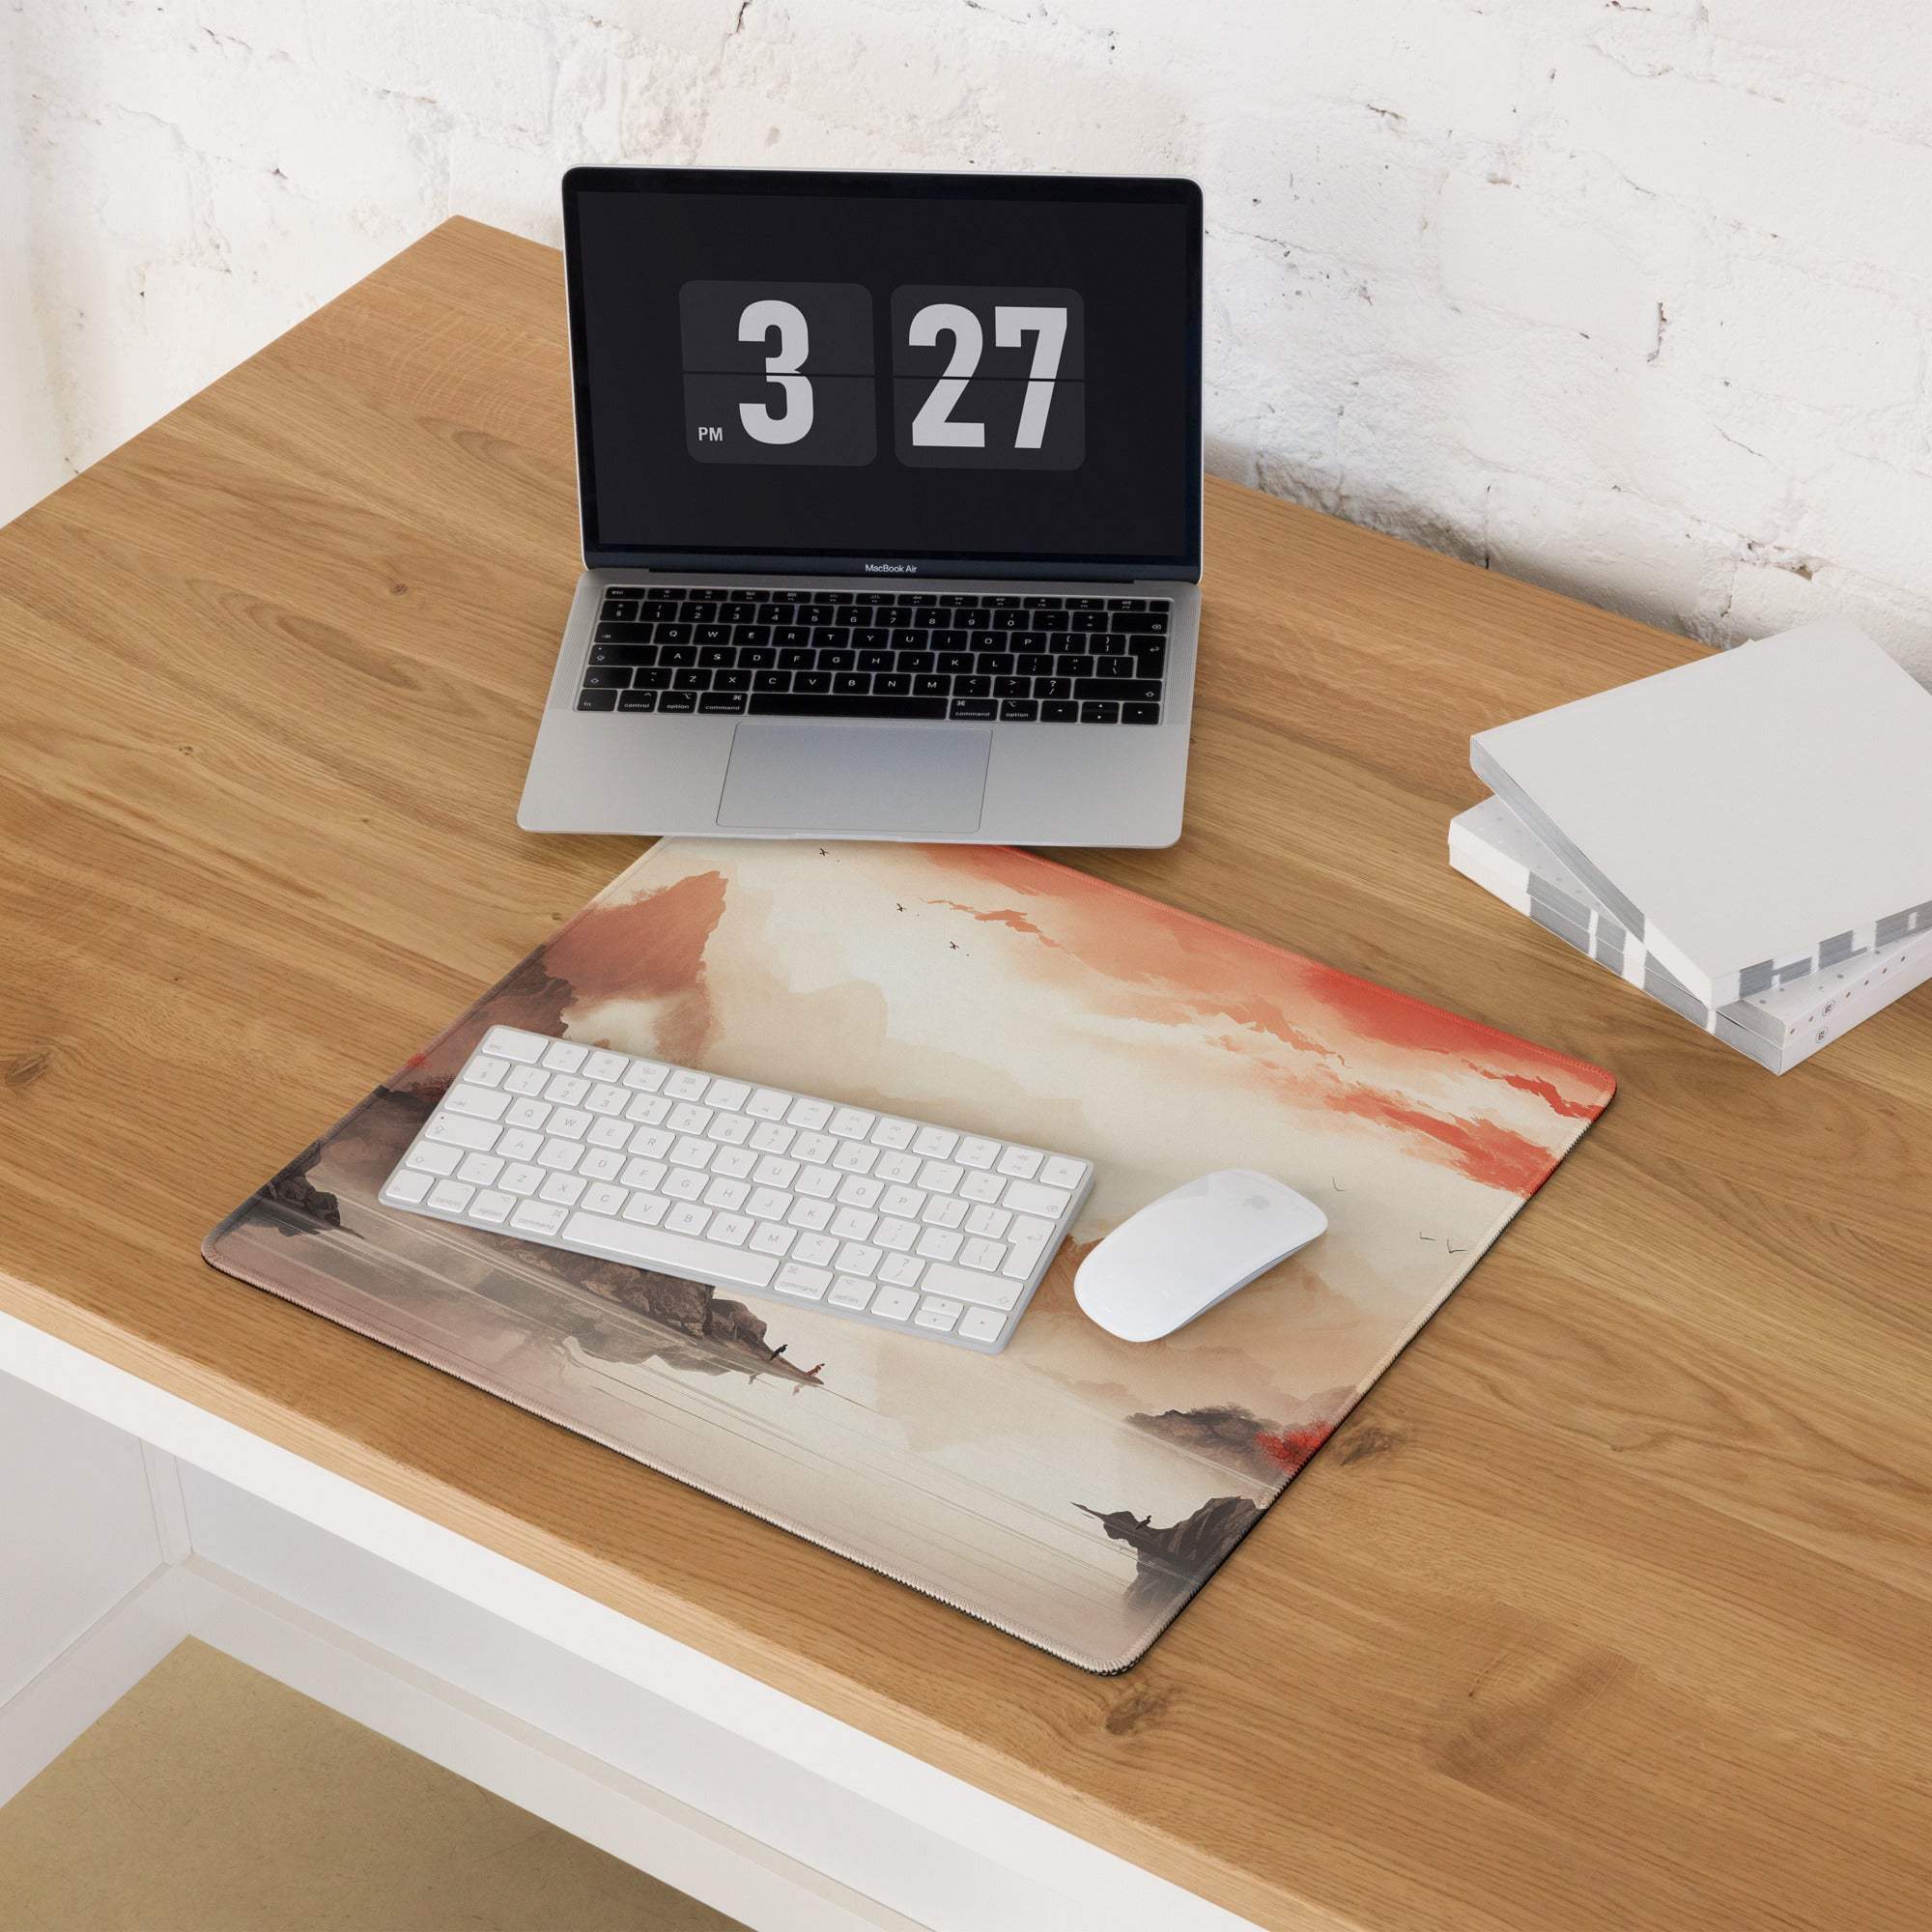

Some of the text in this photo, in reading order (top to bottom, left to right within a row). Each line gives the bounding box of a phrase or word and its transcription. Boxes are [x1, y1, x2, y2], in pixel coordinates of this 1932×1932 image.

[738, 299, 1067, 449] 3 27
[698, 426, 723, 441] PM
[865, 563, 917, 572] MacBook Air
[561, 1090, 570, 1098] 2
[524, 1109, 534, 1117] Q
[565, 1119, 577, 1127] W
[647, 1138, 656, 1146] R
[597, 1159, 607, 1168] D
[772, 1166, 782, 1175] U
[517, 1174, 527, 1183] Z
[681, 1179, 690, 1188] G
[600, 1194, 610, 1202] C
[722, 1190, 733, 1198] H
[683, 1214, 693, 1223] B
[726, 1224, 736, 1233] N
